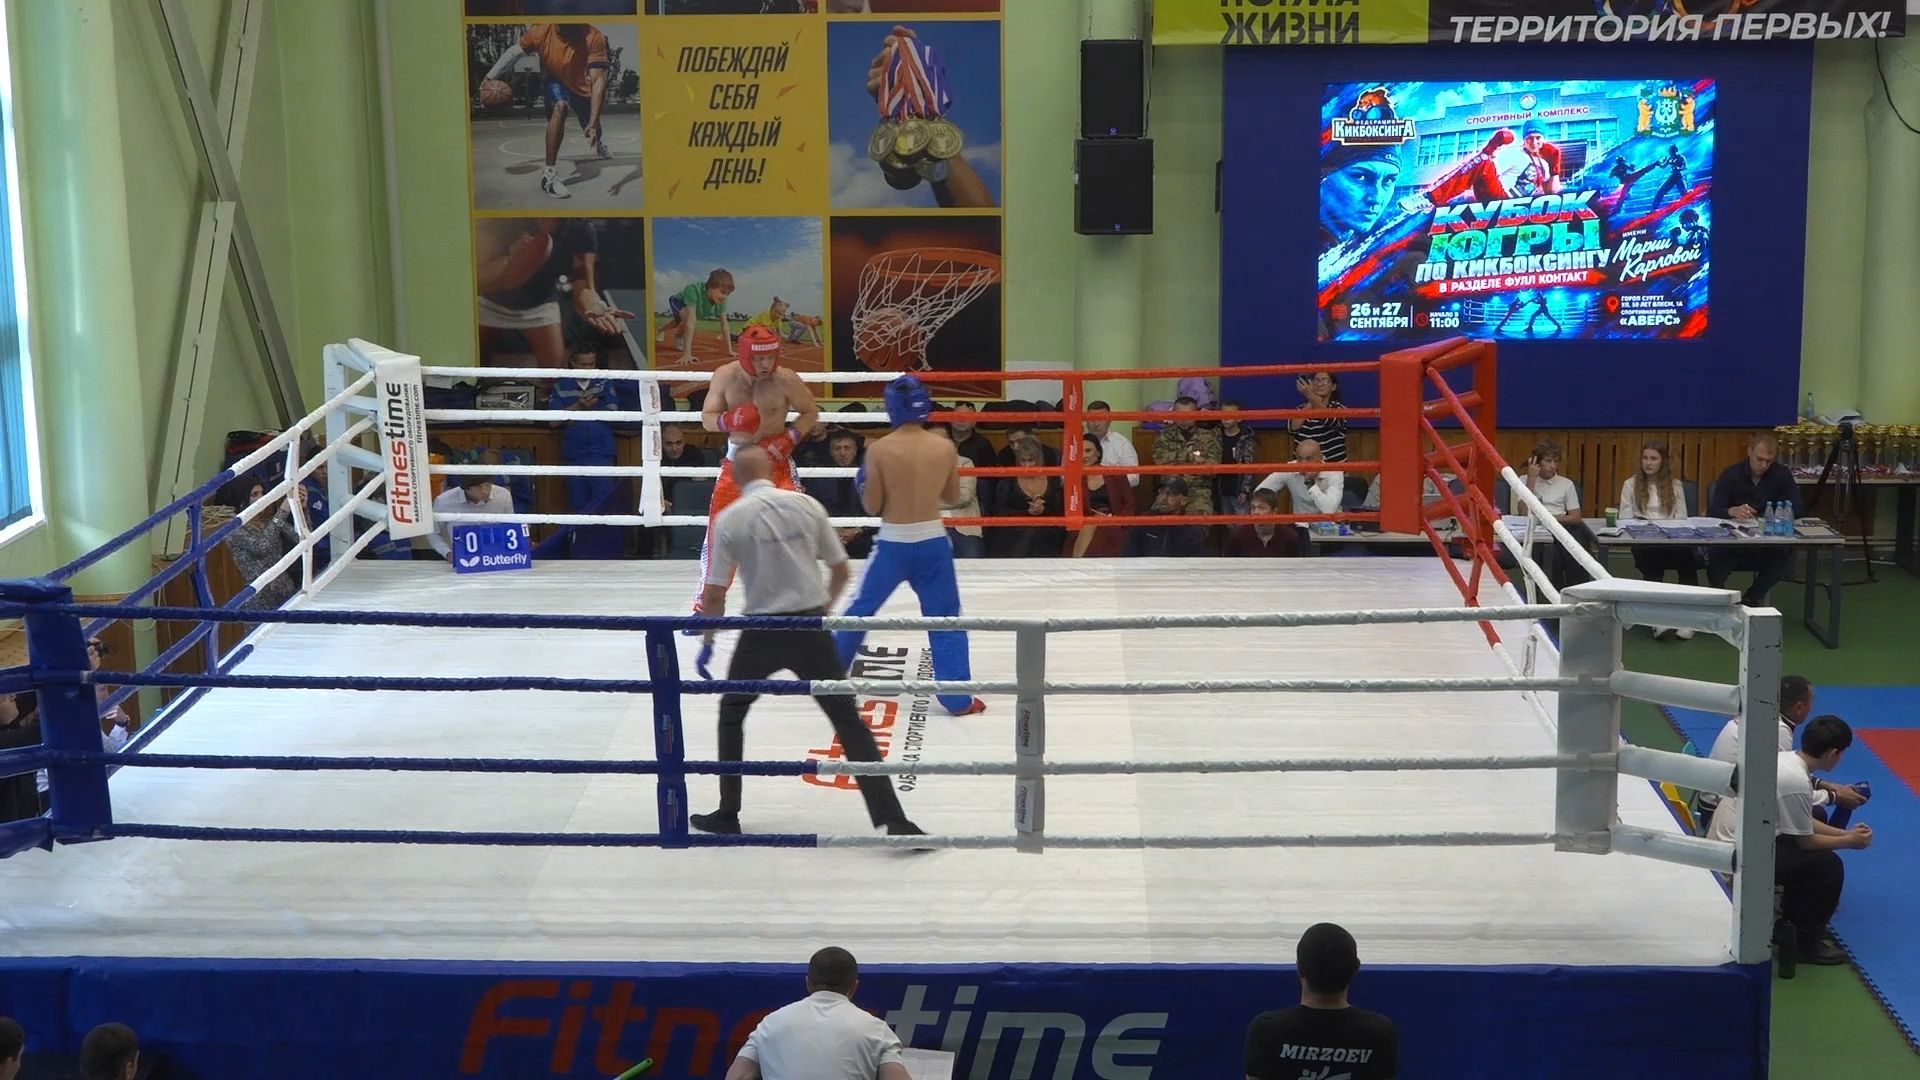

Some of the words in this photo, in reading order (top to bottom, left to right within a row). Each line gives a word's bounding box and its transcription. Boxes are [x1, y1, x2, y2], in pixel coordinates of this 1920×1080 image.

[1220, 12, 1360, 44] ЖИЗНИ
[1450, 14, 1702, 43] ТЕРРИТОРИЯ
[1712, 11, 1892, 41] ПЕРВЫХ!
[677, 42, 789, 78] ПОБЕЖДАЙ
[709, 84, 760, 110] СЕБЯ
[1466, 111, 1532, 125] СПОРТИВНЫЙ
[1537, 106, 1590, 118] КОМПЛЕКС
[688, 116, 782, 153] КАЖДЫЙ
[703, 158, 766, 190] ДЕНЬ!
[1428, 190, 1599, 236] КУБОК
[1425, 219, 1601, 262] ЮГРЫ
[1622, 229, 1647, 237] ИМЕНИ
[1612, 237, 1673, 264] Марии
[1619, 243, 1702, 282] Карловой
[1415, 261, 1447, 283] ПО
[1453, 249, 1611, 279] КИКБОКСИНГУ
[1439, 282, 1448, 293] В
[1451, 277, 1502, 292] РАЗДЕЛЕ
[1504, 274, 1536, 287] ФУЛЛ
[1538, 270, 1588, 285] КОНТАКТ
[1349, 316, 1409, 328] СЕНТЯБРЯ
[1350, 303, 1371, 316] 26
[1382, 303, 1401, 316] 27
[1619, 315, 1681, 326] «АВЕРС»
[1429, 318, 1460, 328] 11:00
[384, 382, 413, 524] Fitnestime
[465, 532, 478, 553] 0
[506, 529, 518, 550] 3
[482, 553, 527, 566] Butterfly
[1279, 1044, 1373, 1063] MIRZOEV
